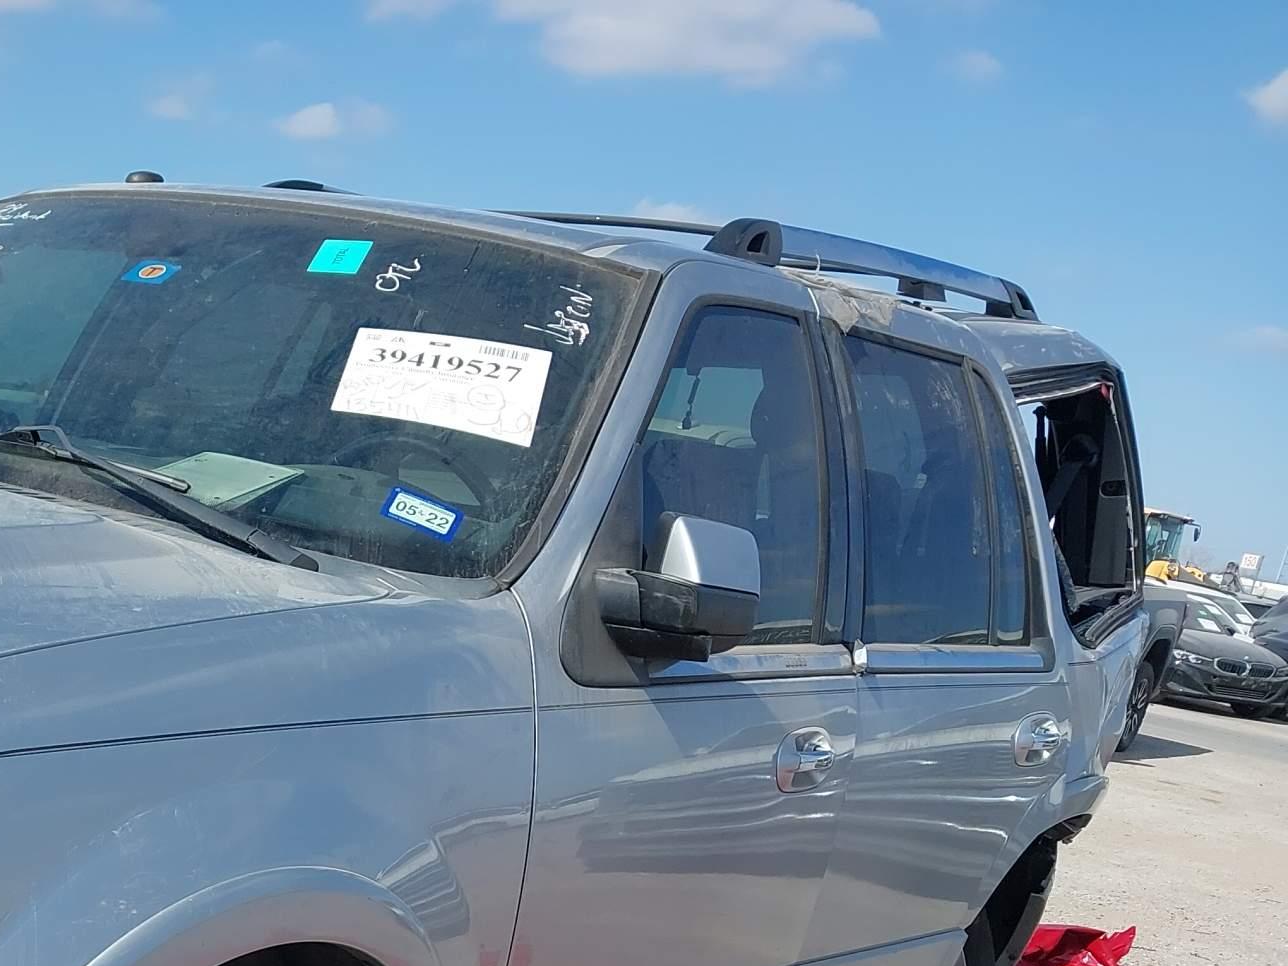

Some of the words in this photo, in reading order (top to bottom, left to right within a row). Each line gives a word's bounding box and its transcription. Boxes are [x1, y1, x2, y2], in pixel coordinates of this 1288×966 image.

[368, 347, 523, 383] 39419527
[395, 500, 419, 516] 05
[425, 512, 450, 530] 22
